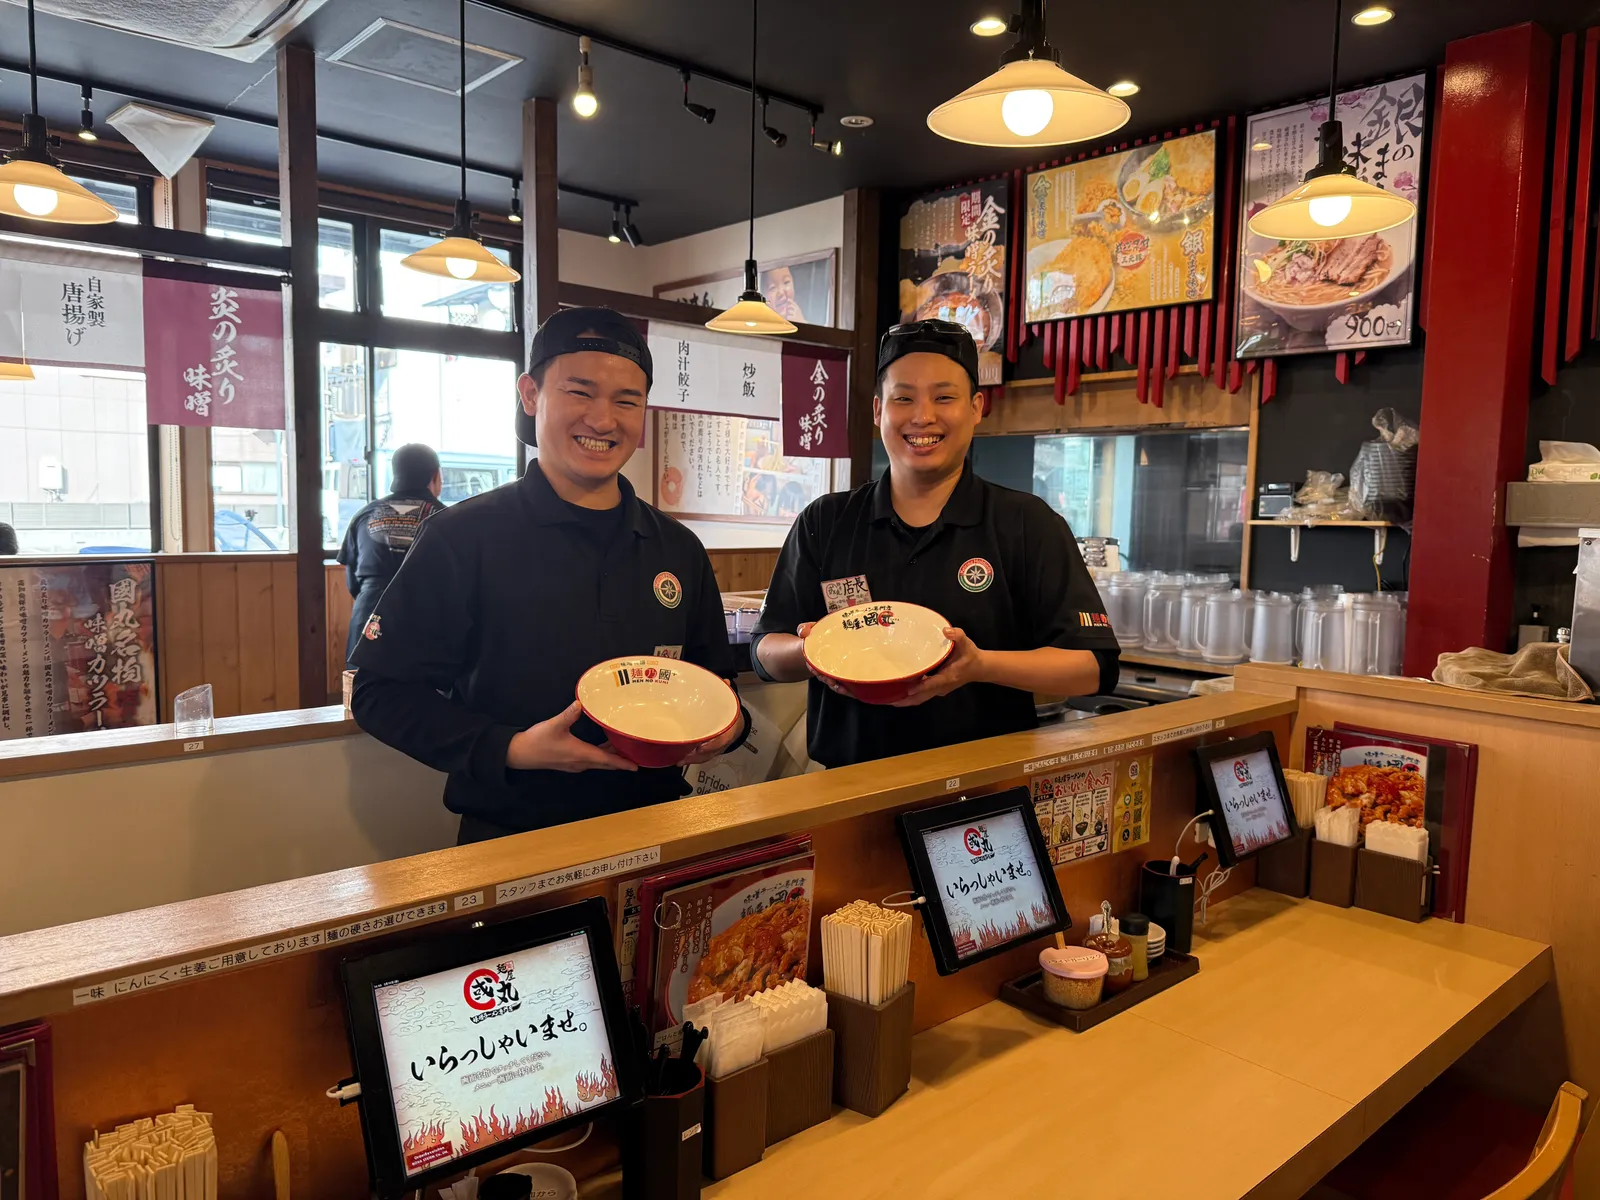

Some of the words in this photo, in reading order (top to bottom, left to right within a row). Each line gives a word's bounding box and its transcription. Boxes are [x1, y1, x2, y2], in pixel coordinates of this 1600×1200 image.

[960, 200, 971, 227] 限定
[970, 189, 982, 219] 期間
[977, 194, 1006, 294] 金の炙り
[60, 281, 87, 347] 唐揚げ
[86, 275, 106, 328] 自家製
[208, 286, 245, 406] 炎の炙り
[677, 339, 690, 403] 肉汁餃子
[183, 363, 213, 418] 味噌
[742, 362, 757, 398] 炒飯
[810, 359, 829, 446] 金の炙り
[798, 413, 813, 451] 味噌
[843, 576, 869, 596] 店長
[109, 577, 143, 685] 國丸名物
[84, 612, 109, 730] 味噌カツラー
[188, 742, 200, 750] 27
[948, 780, 957, 788] 22
[461, 895, 477, 907] 23
[498, 851, 659, 900] スタッフまでお気軽にお申し付け下さい
[945, 860, 1032, 898] いらっしゃいませ。
[326, 902, 447, 943] 麺の硬さお選びできます
[75, 987, 105, 1000] 一味
[114, 933, 321, 995] にんにく・生姜ご用意しております
[410, 1009, 588, 1081] いらっしゃいませ。
